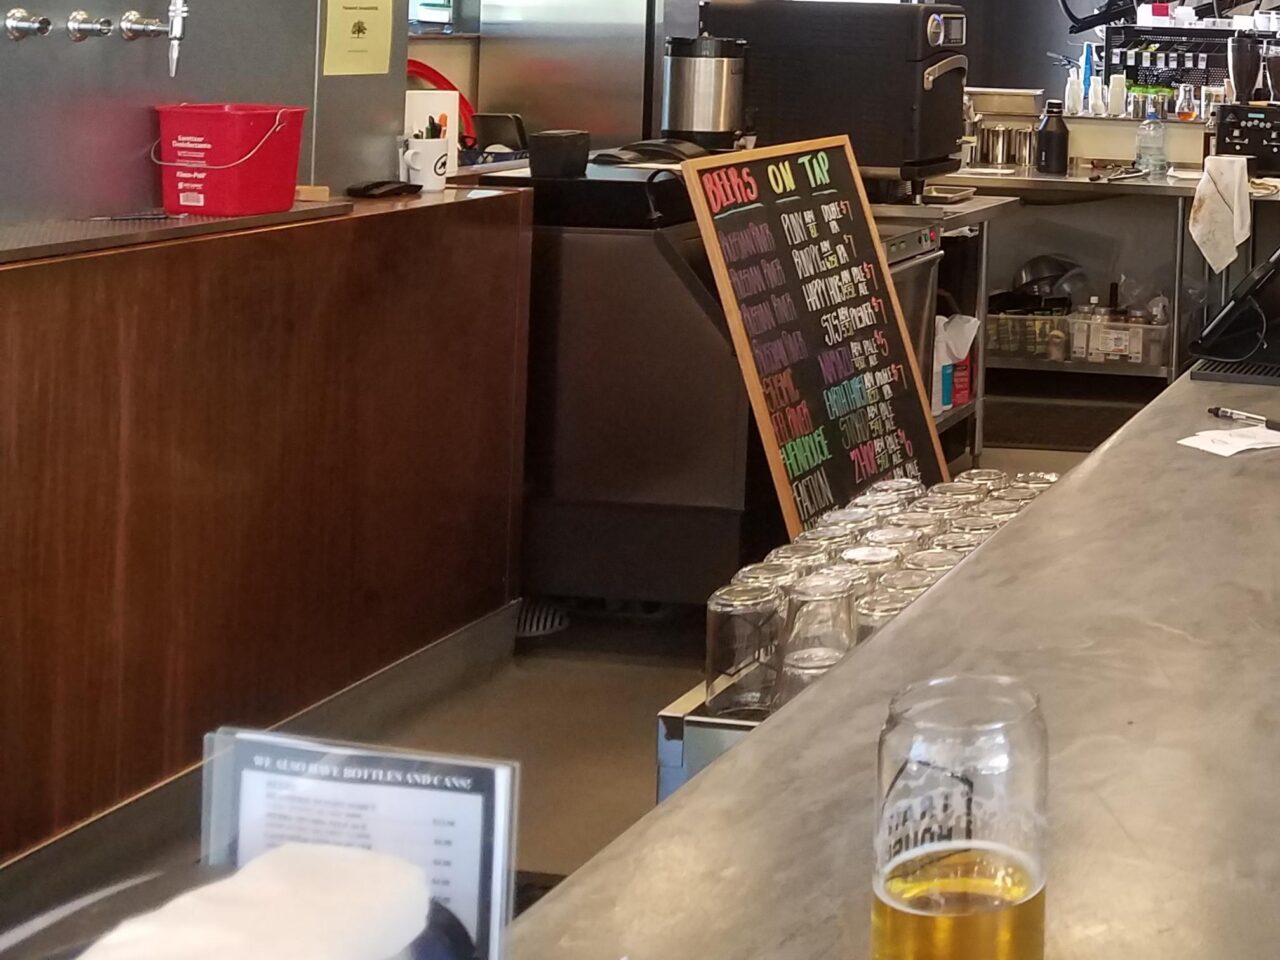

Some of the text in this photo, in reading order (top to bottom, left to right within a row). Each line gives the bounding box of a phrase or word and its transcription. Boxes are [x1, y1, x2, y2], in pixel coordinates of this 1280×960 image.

[702, 151, 830, 213] BEERS ON TAP
[840, 200, 854, 221] $7
[863, 261, 878, 290] $7
[821, 311, 843, 346] STS
[871, 296, 888, 324] $7
[780, 425, 832, 480] HENHOUSE
[792, 466, 835, 521] FACTION
[343, 767, 402, 783] BOTTLES
